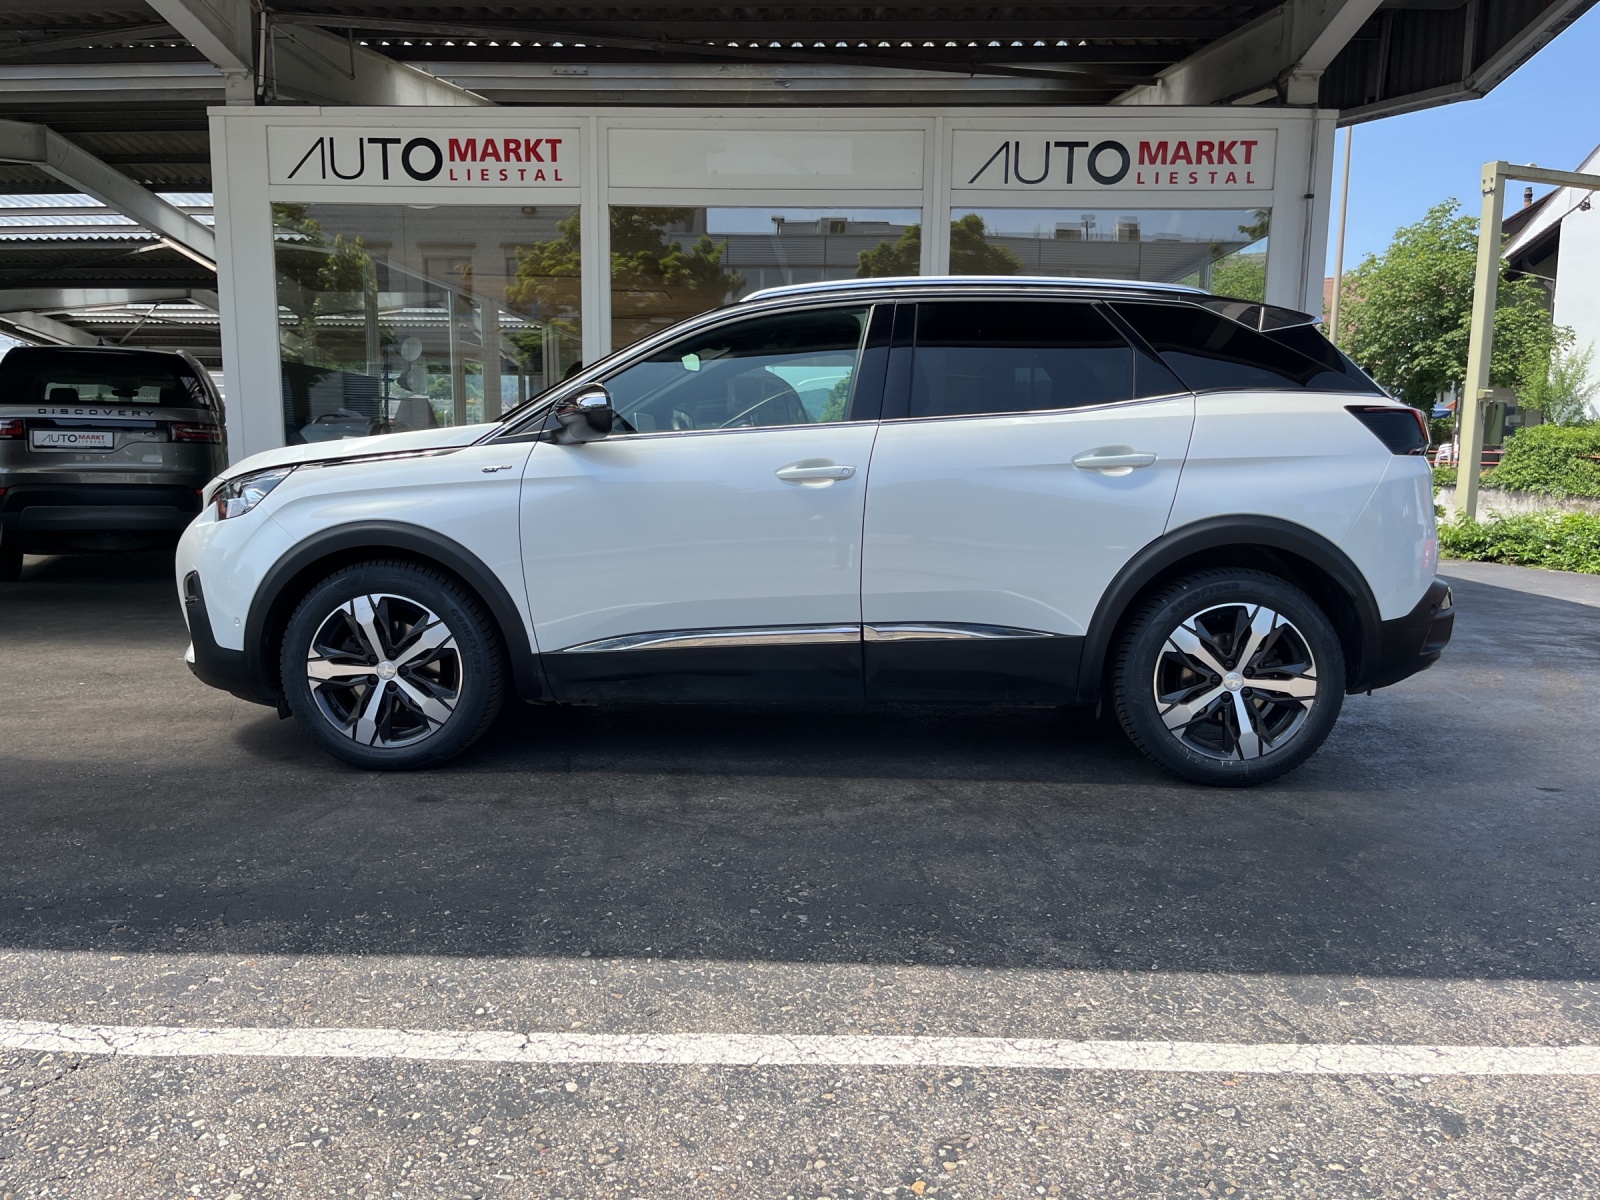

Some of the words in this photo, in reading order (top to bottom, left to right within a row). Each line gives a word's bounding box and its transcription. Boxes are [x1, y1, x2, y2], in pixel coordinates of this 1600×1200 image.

[287, 137, 443, 181] AUTO
[449, 138, 562, 162] MARKT
[968, 140, 1131, 185] AUTO
[1138, 140, 1258, 165] MARKT
[449, 168, 563, 181] LIESTAL
[1137, 171, 1255, 185] LIESTAL
[38, 408, 154, 416] DISCOVERY
[42, 434, 77, 443] AUTO
